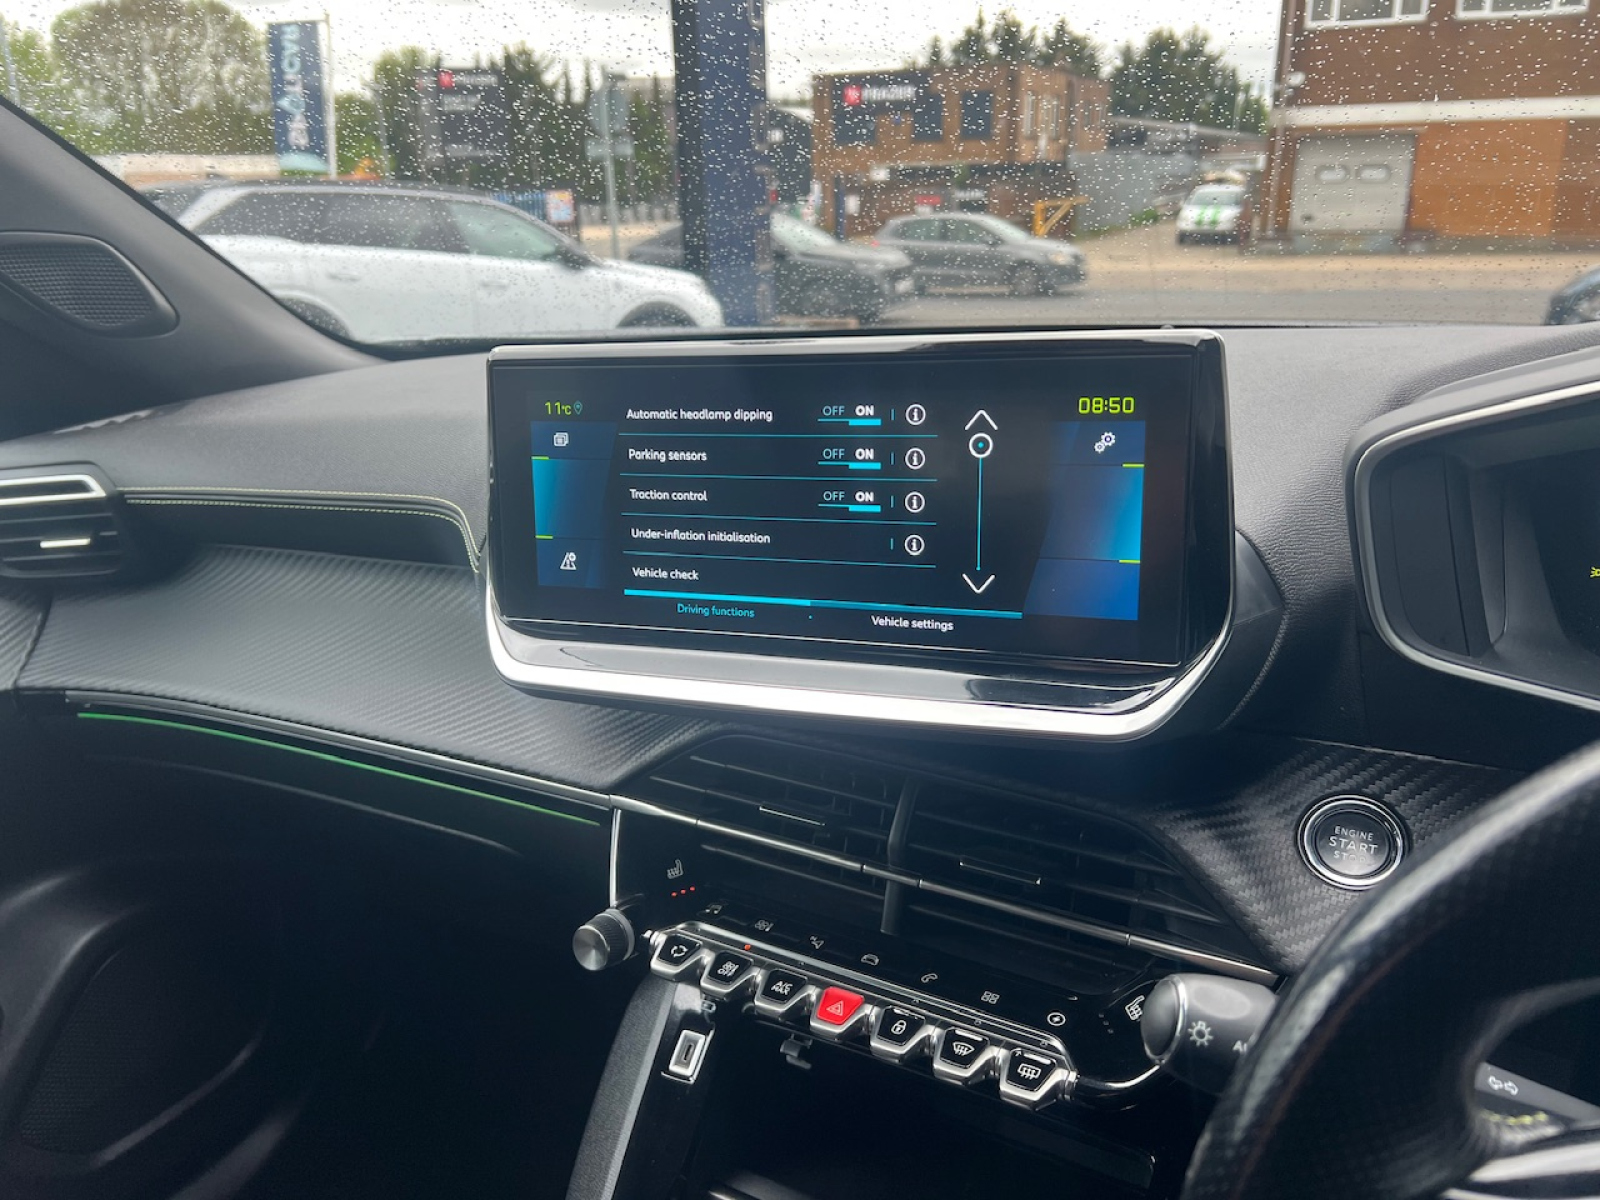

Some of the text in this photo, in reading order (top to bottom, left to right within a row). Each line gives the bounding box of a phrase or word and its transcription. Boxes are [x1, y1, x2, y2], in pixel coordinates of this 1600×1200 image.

[822, 405, 875, 417] OFF ON
[1078, 396, 1135, 414] 08:50
[626, 408, 773, 423] Automatic headlamp dipping
[628, 448, 707, 463] Parking sensors
[822, 448, 874, 460] OFF ON
[629, 488, 708, 502] Traction control
[823, 490, 874, 502] OFF ON
[631, 528, 771, 544] Under-inflation initialisation
[632, 567, 699, 581] Vehicle check
[677, 602, 755, 618] Driving functions
[871, 615, 954, 632] Vehicle settings
[1334, 825, 1374, 841] ENGINE
[1329, 836, 1378, 855] START
[1333, 850, 1366, 863] STOP
